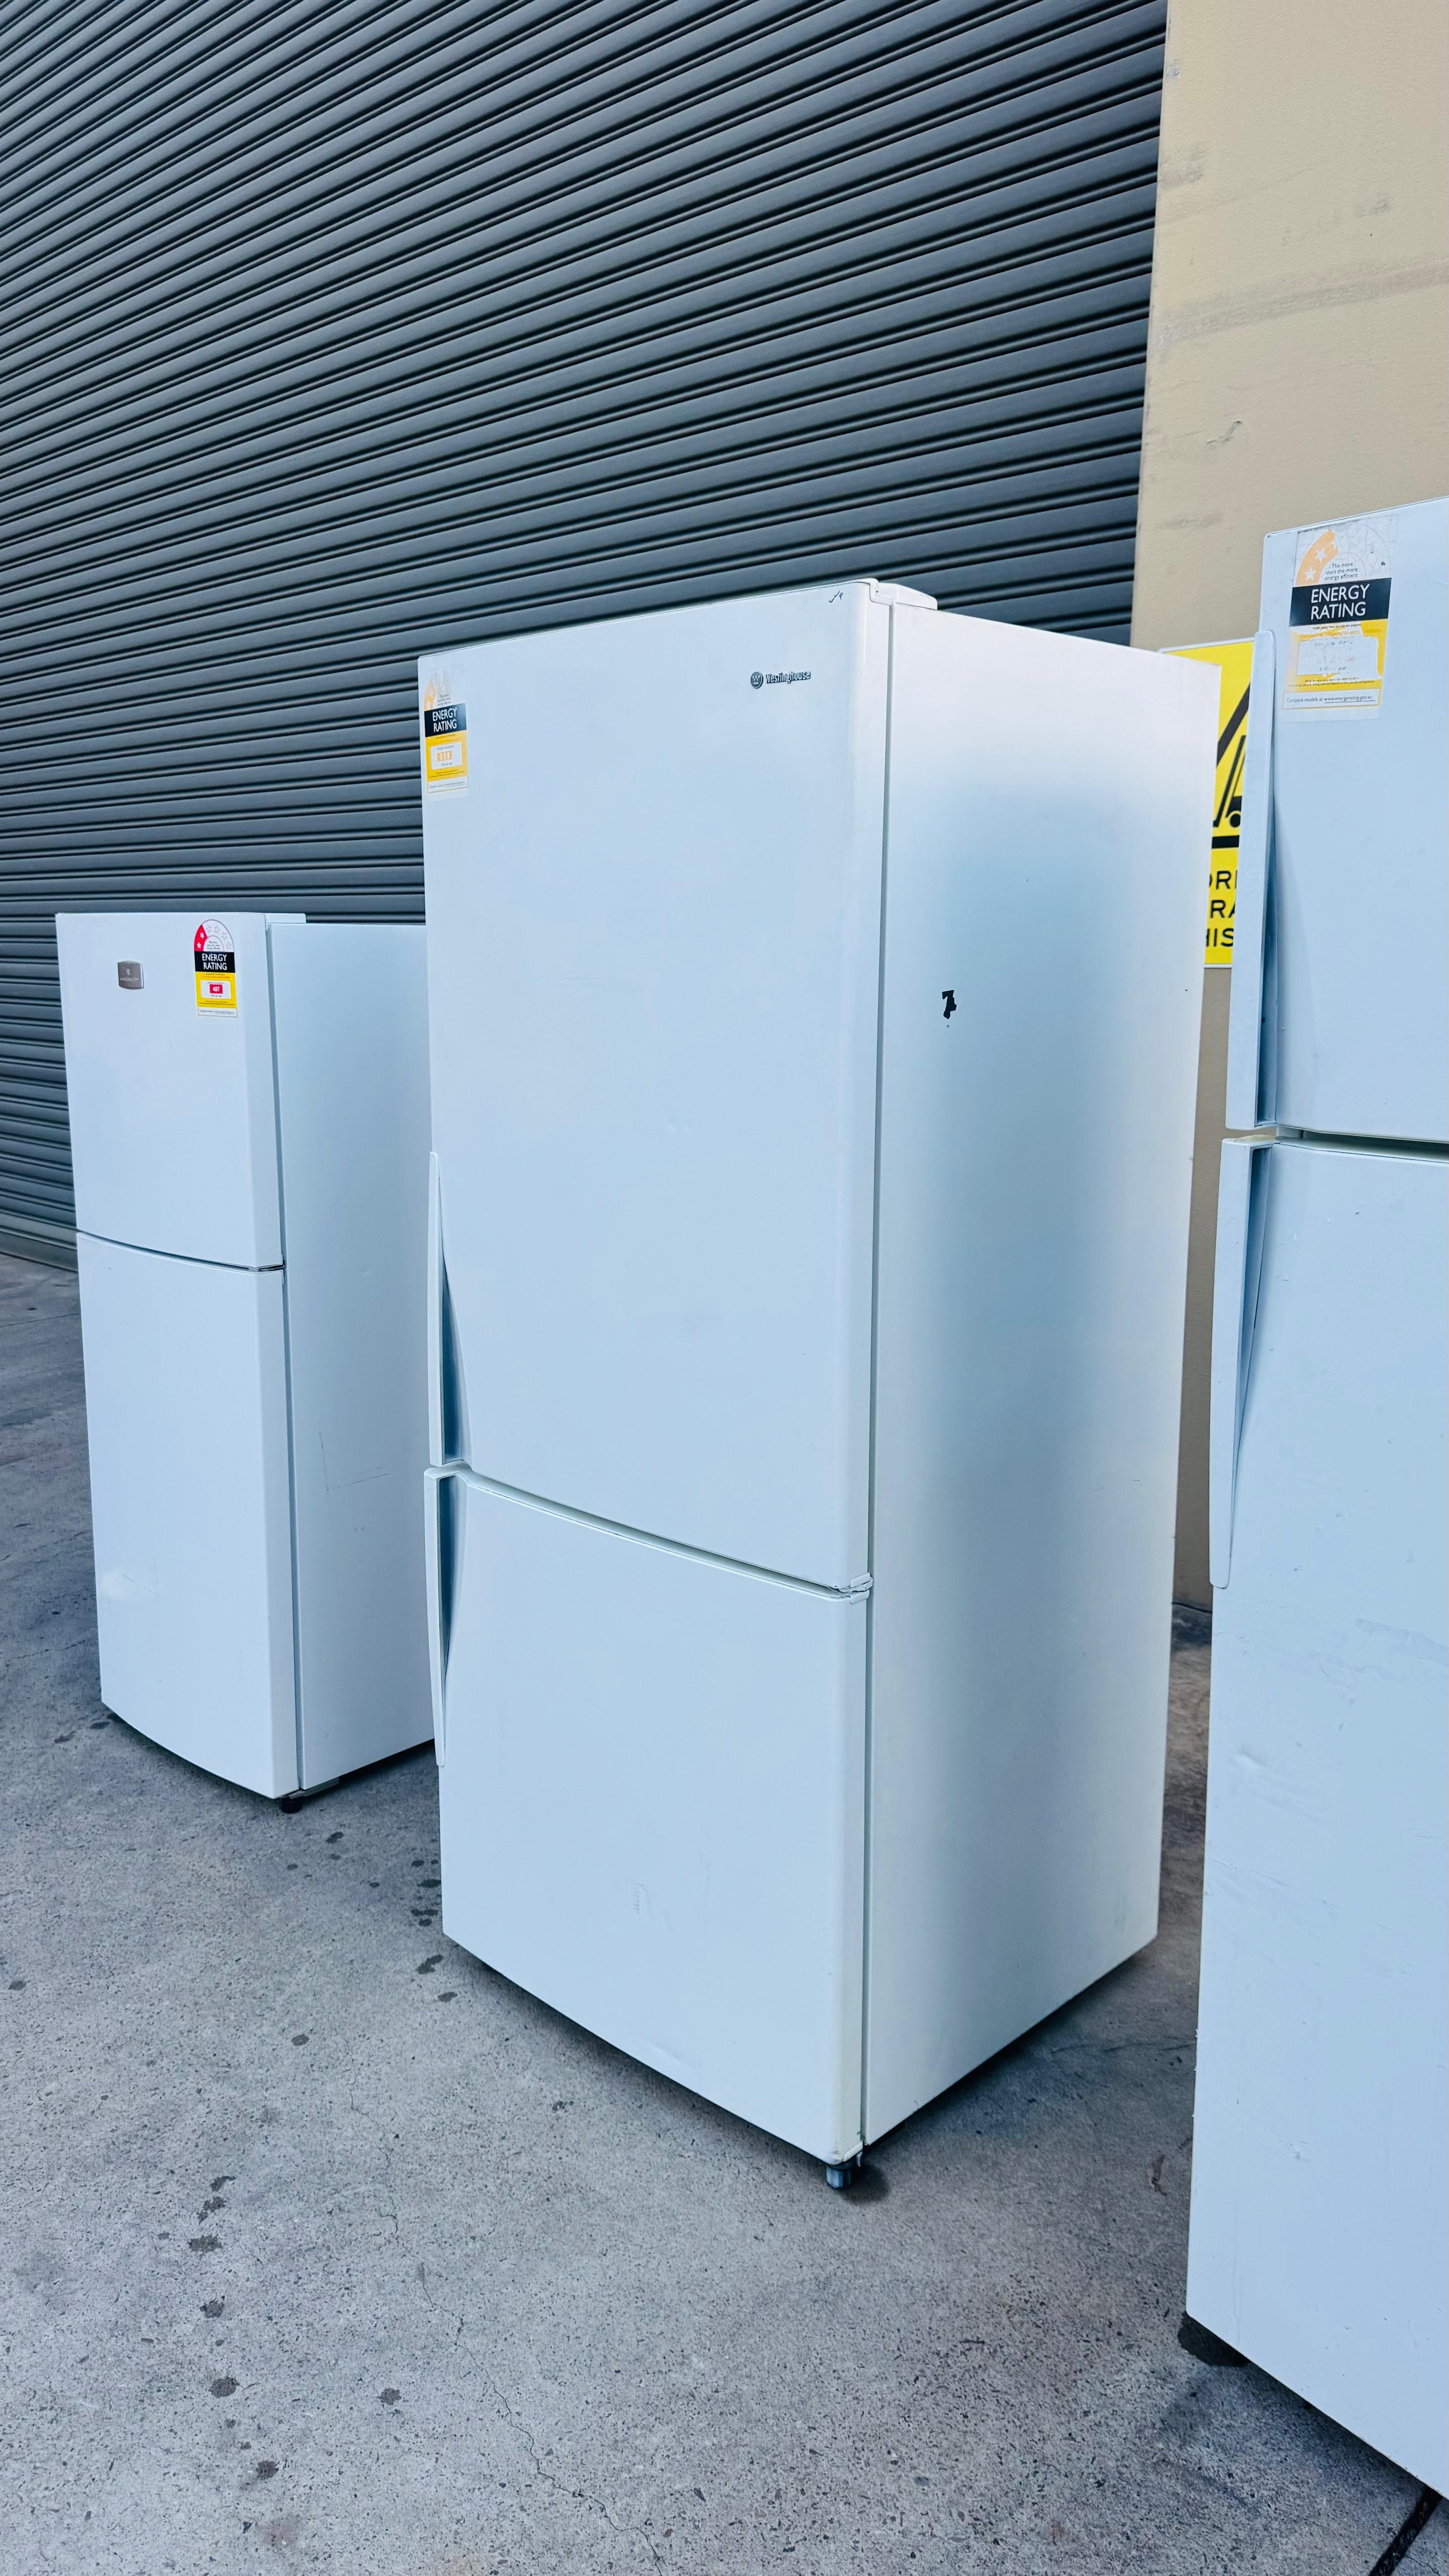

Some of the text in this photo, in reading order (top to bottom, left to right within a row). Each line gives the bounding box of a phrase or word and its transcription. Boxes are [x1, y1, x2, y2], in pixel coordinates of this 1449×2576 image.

[1311, 584, 1370, 603] ENERGY
[1311, 601, 1366, 620] RATING
[432, 707, 457, 721] ENERGY
[433, 719, 457, 733] RATING
[202, 953, 227, 961] ENERGY
[203, 962, 227, 970] RATING
